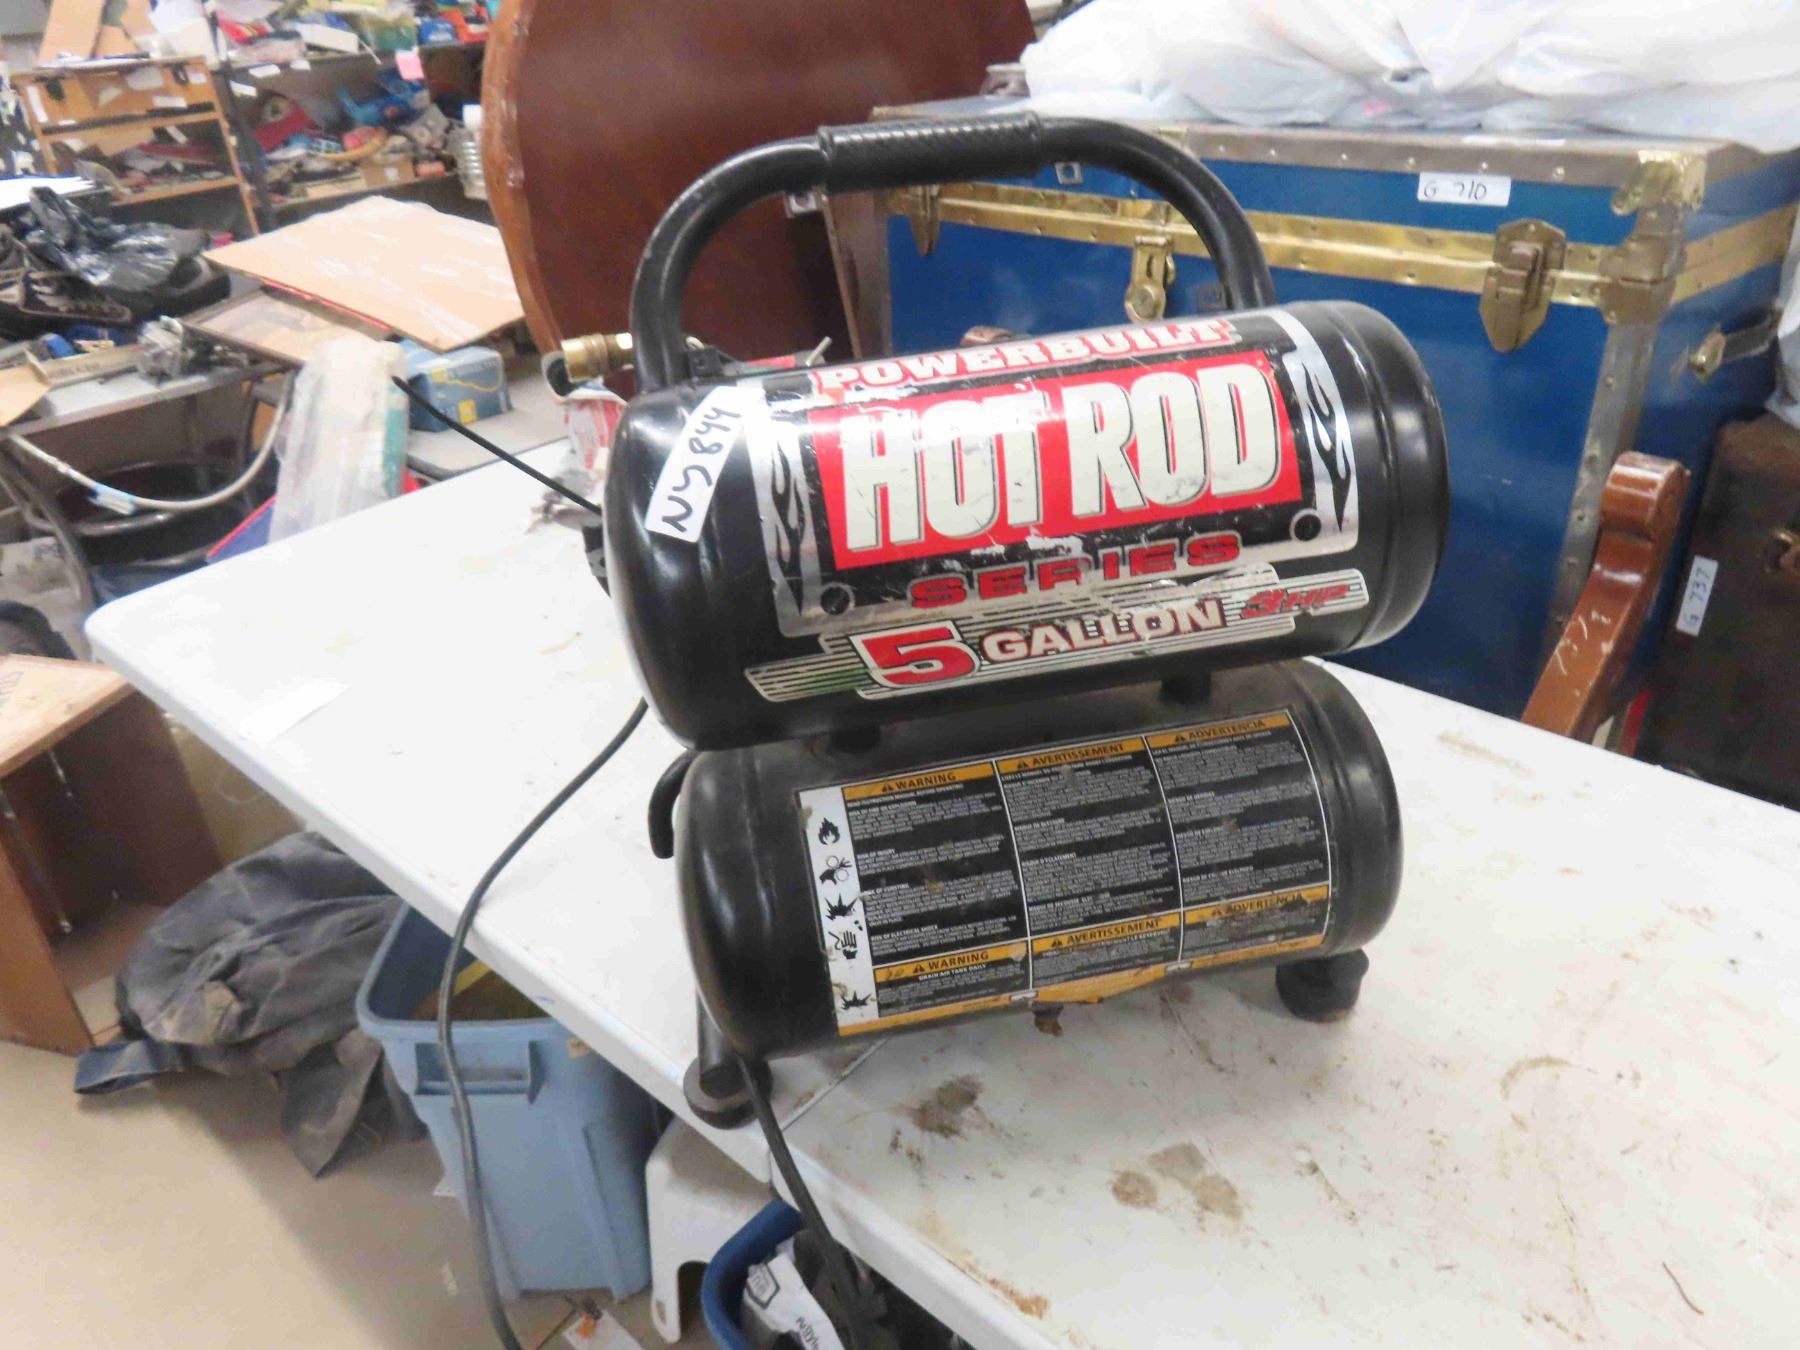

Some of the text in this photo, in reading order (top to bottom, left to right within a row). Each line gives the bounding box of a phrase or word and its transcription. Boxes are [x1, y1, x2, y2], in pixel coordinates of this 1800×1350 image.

[813, 319, 1232, 390] POWERBUILT
[840, 364, 1279, 551] HOT ROD
[909, 534, 1241, 609] SERIES
[850, 583, 1351, 688] 5 GALLON 3HP
[1188, 719, 1266, 740] ADVERTENCIA
[1032, 743, 1124, 767] AVERTISSEMENT
[897, 773, 956, 790] WARNING
[1067, 919, 1160, 944] AVERTISSEMENT
[928, 952, 988, 970] WARNING
